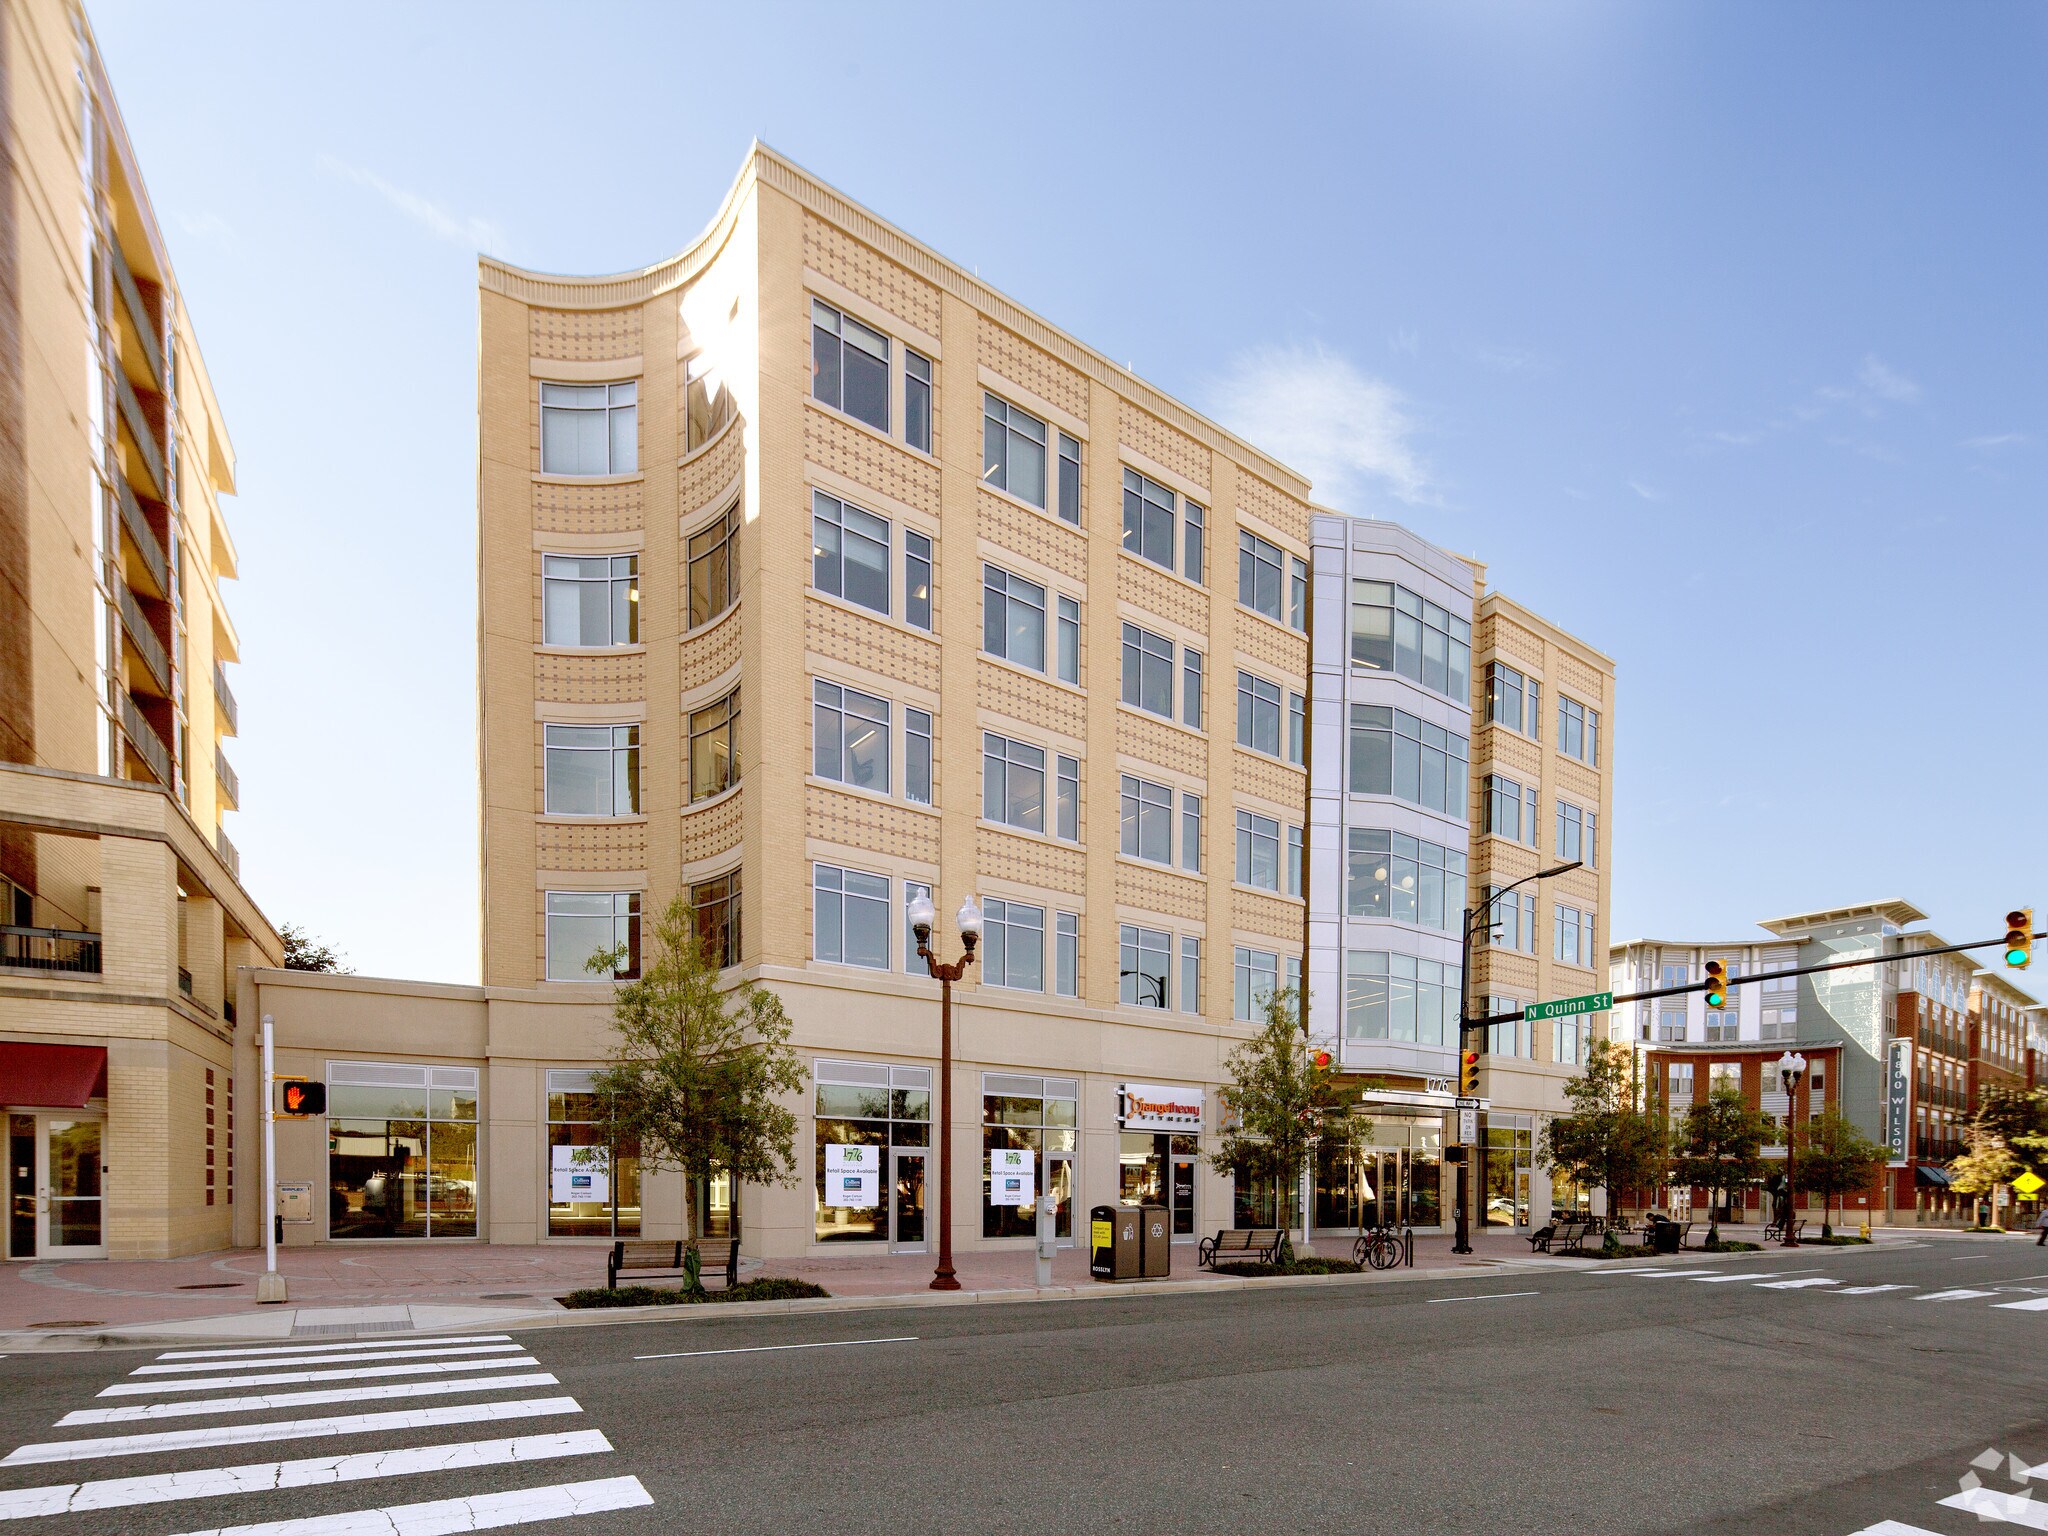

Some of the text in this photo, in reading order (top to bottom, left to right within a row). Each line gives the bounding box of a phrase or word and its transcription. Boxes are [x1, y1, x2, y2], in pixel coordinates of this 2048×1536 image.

[1528, 995, 1608, 1019] N Quinn St
[1425, 1077, 1449, 1092] 1776
[1128, 1094, 1200, 1117] Orangetheory
[1891, 1051, 1905, 1155] 1800 WILSON
[1142, 1114, 1200, 1123] FITNESS
[843, 1148, 863, 1162] 1776
[1005, 1152, 1021, 1165] 1776
